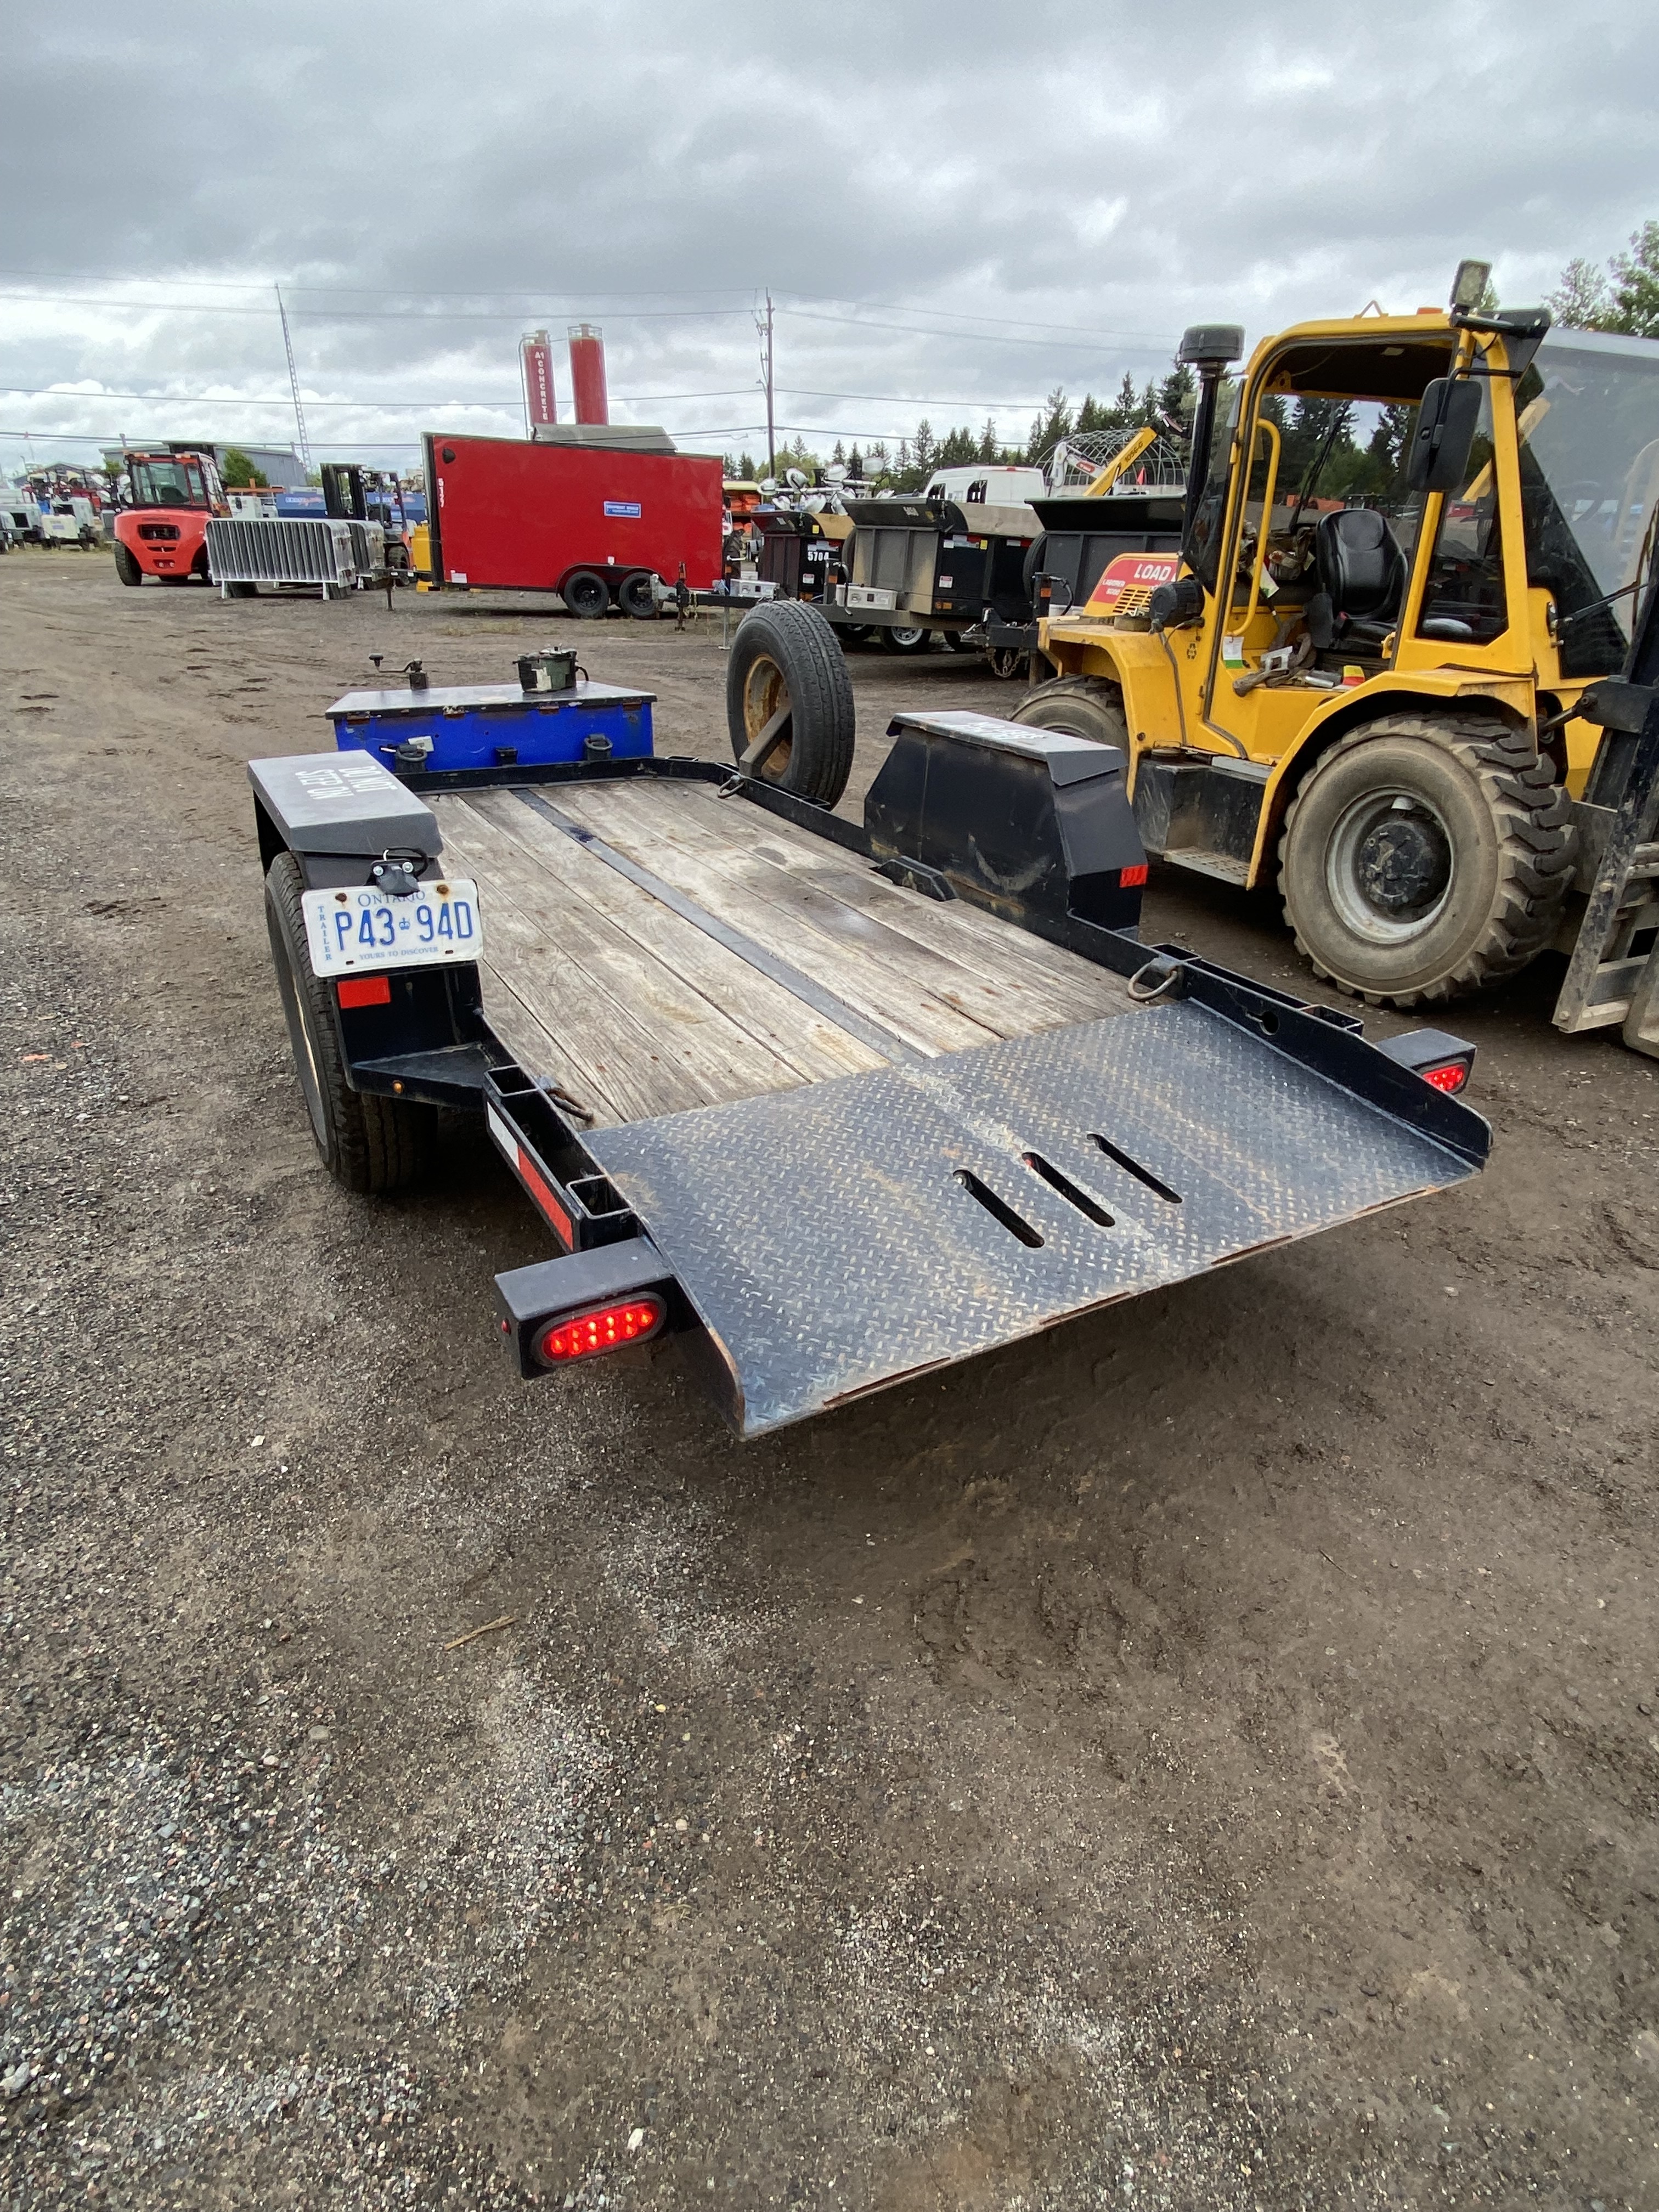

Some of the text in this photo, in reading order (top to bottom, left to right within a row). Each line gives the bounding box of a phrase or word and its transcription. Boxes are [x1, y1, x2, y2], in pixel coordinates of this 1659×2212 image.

[538, 360, 548, 420] CONCRETE
[1133, 563, 1172, 581] LOAD
[295, 769, 355, 800] STEP ON
[338, 765, 398, 792] DO NOT
[318, 906, 332, 961] TRAILER
[335, 901, 473, 951] P43 94D
[359, 951, 385, 960] YOURS
[401, 946, 438, 956] DISCOVER
